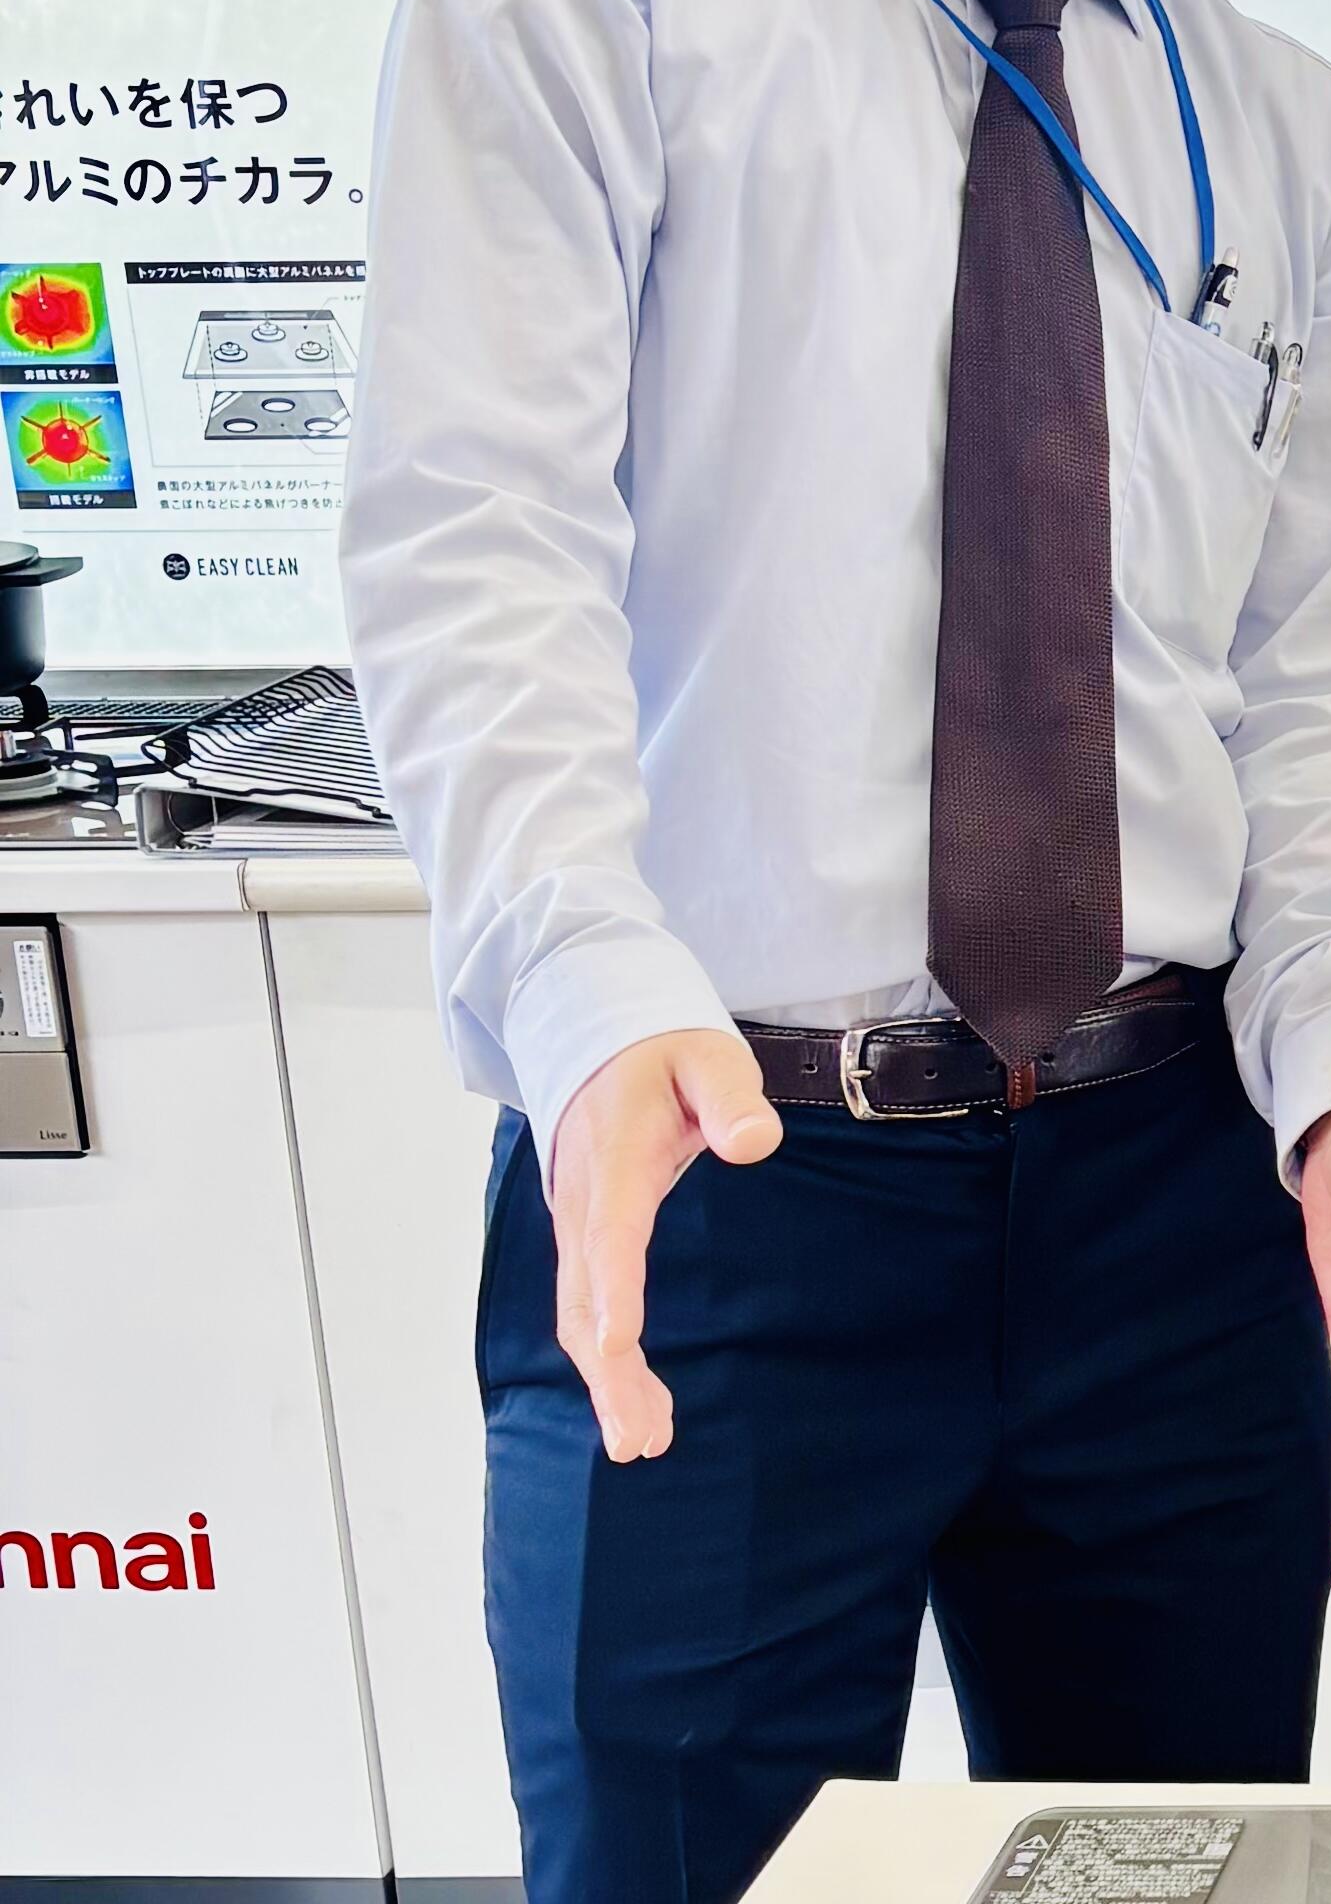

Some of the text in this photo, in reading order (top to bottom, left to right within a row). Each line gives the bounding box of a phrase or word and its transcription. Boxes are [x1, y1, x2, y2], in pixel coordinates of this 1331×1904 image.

[0, 77, 288, 131] れいを保つ
[198, 556, 300, 577] EASY CLEAN
